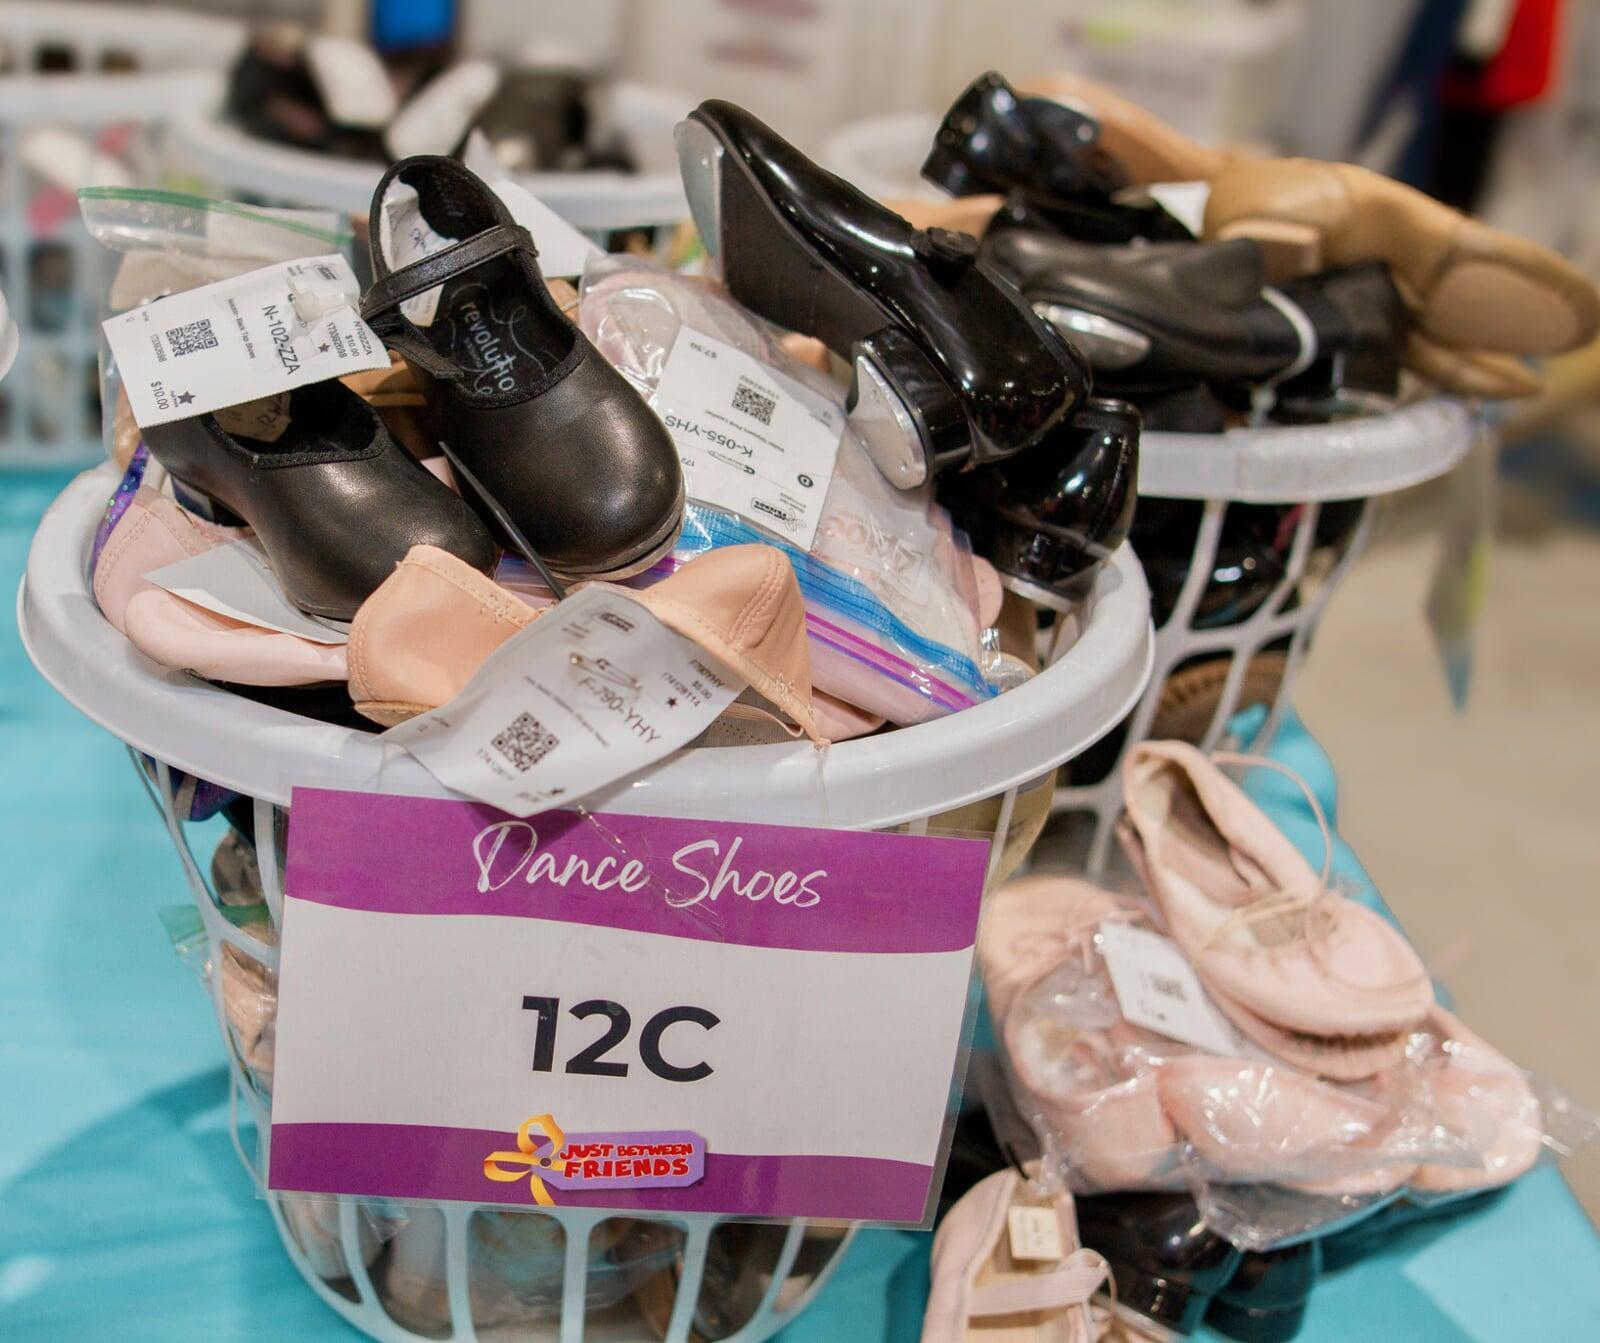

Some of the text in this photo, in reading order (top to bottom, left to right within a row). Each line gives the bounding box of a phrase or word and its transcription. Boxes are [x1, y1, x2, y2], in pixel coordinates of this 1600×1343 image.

[262, 304, 301, 375] N-102-ZZA
[345, 334, 360, 357] $10.00
[353, 320, 373, 356] N102ZZA
[460, 301, 518, 392] revolutio
[150, 381, 169, 410] $10.00
[664, 415, 753, 458] K-055-YHS
[473, 821, 828, 908] Dance Shoes
[521, 995, 721, 1082] 12C
[560, 1143, 694, 1160] JUST BETWEEN
[563, 1158, 689, 1179] FRIENDS
